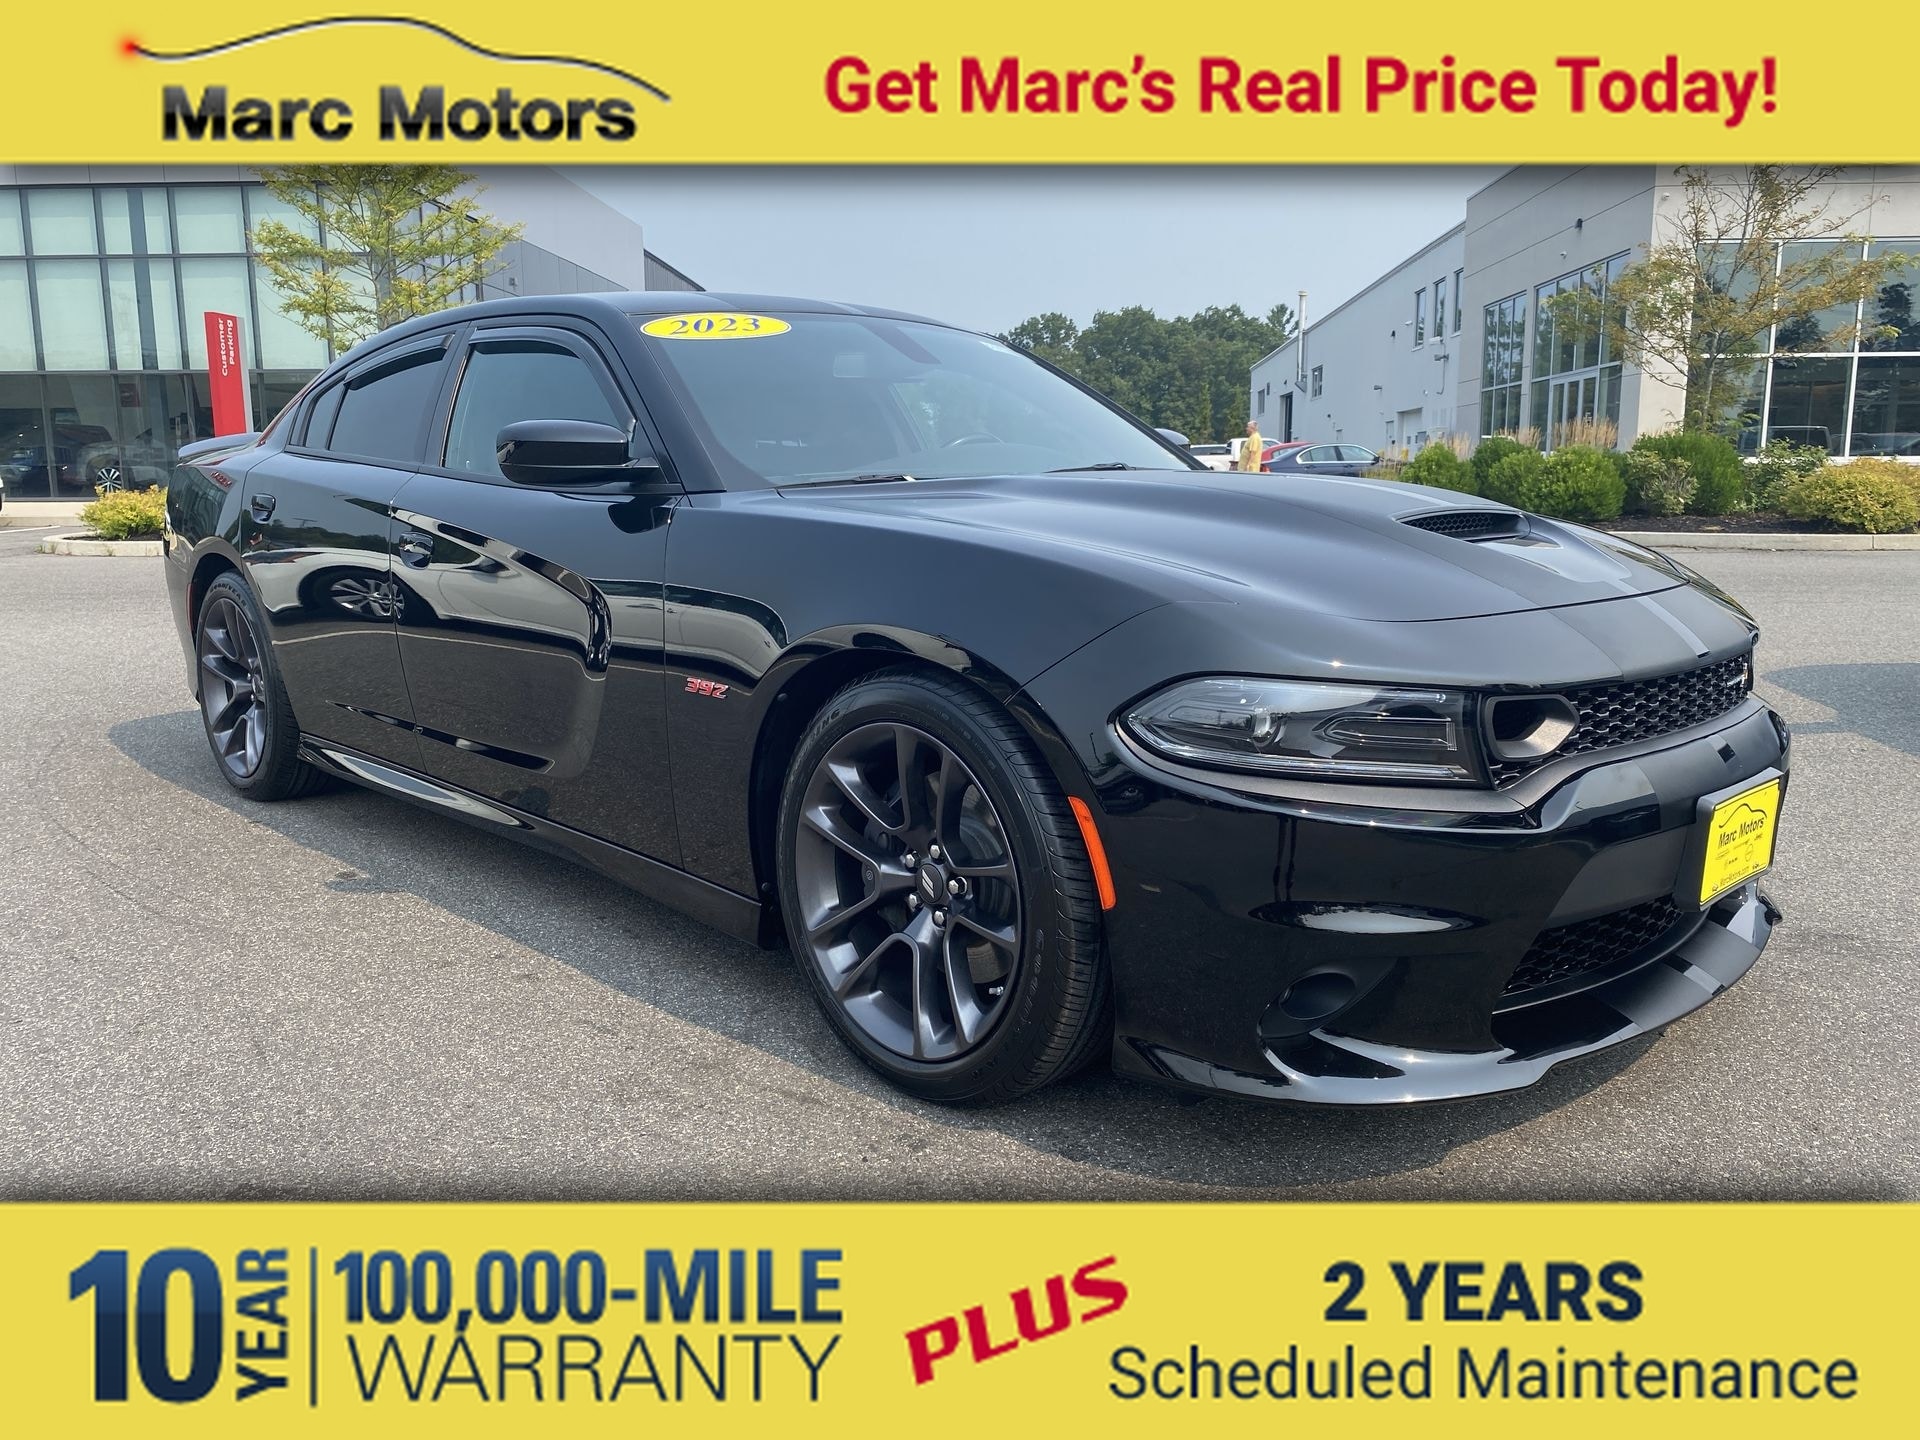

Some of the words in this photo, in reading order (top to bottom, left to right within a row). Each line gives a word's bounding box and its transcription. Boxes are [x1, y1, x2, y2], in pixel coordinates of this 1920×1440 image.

[226, 319, 235, 365] Parking
[669, 317, 761, 335] 2023
[218, 317, 228, 376] Customer
[684, 676, 729, 700] 392
[1718, 830, 1738, 849] Marc
[1739, 817, 1765, 839] Motors
